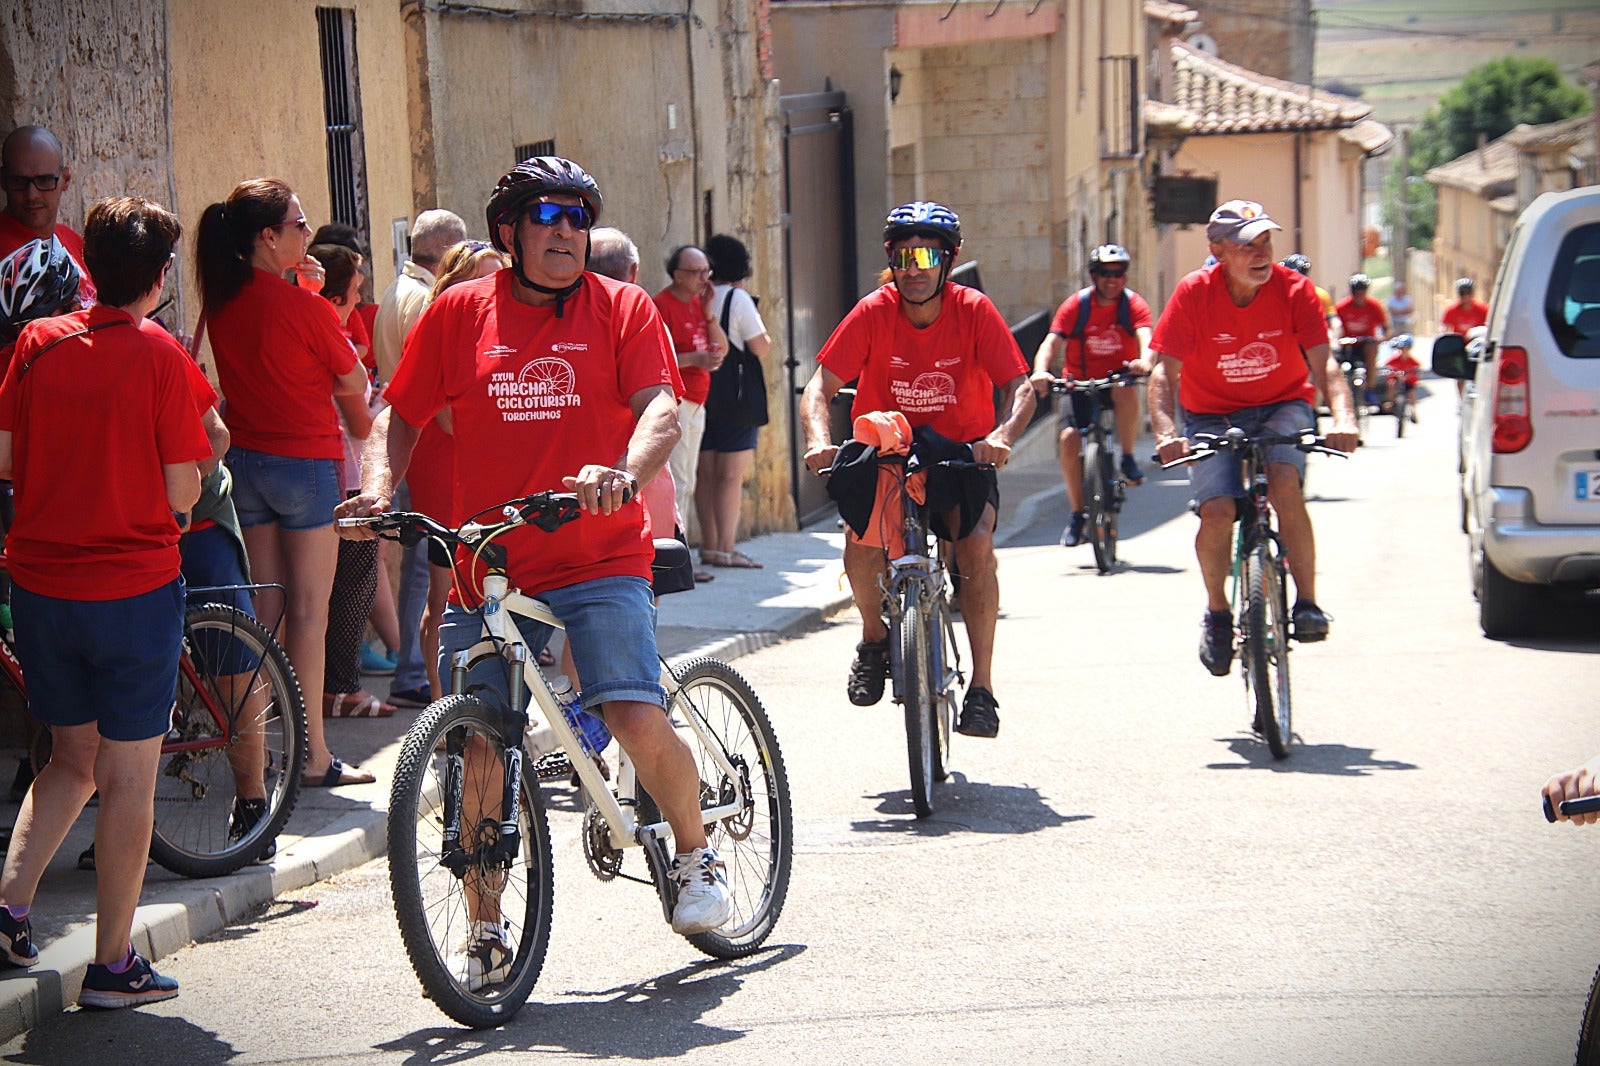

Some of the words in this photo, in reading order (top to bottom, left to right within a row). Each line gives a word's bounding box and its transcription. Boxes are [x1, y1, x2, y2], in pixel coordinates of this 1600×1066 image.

[492, 372, 514, 382] XXVII
[488, 381, 548, 397] MARCHA
[891, 386, 934, 398] MARCHA
[497, 394, 581, 409] CICLOTURISTA
[896, 395, 957, 406] CICLOTURISTA
[502, 410, 561, 422] TORDEHUMOS
